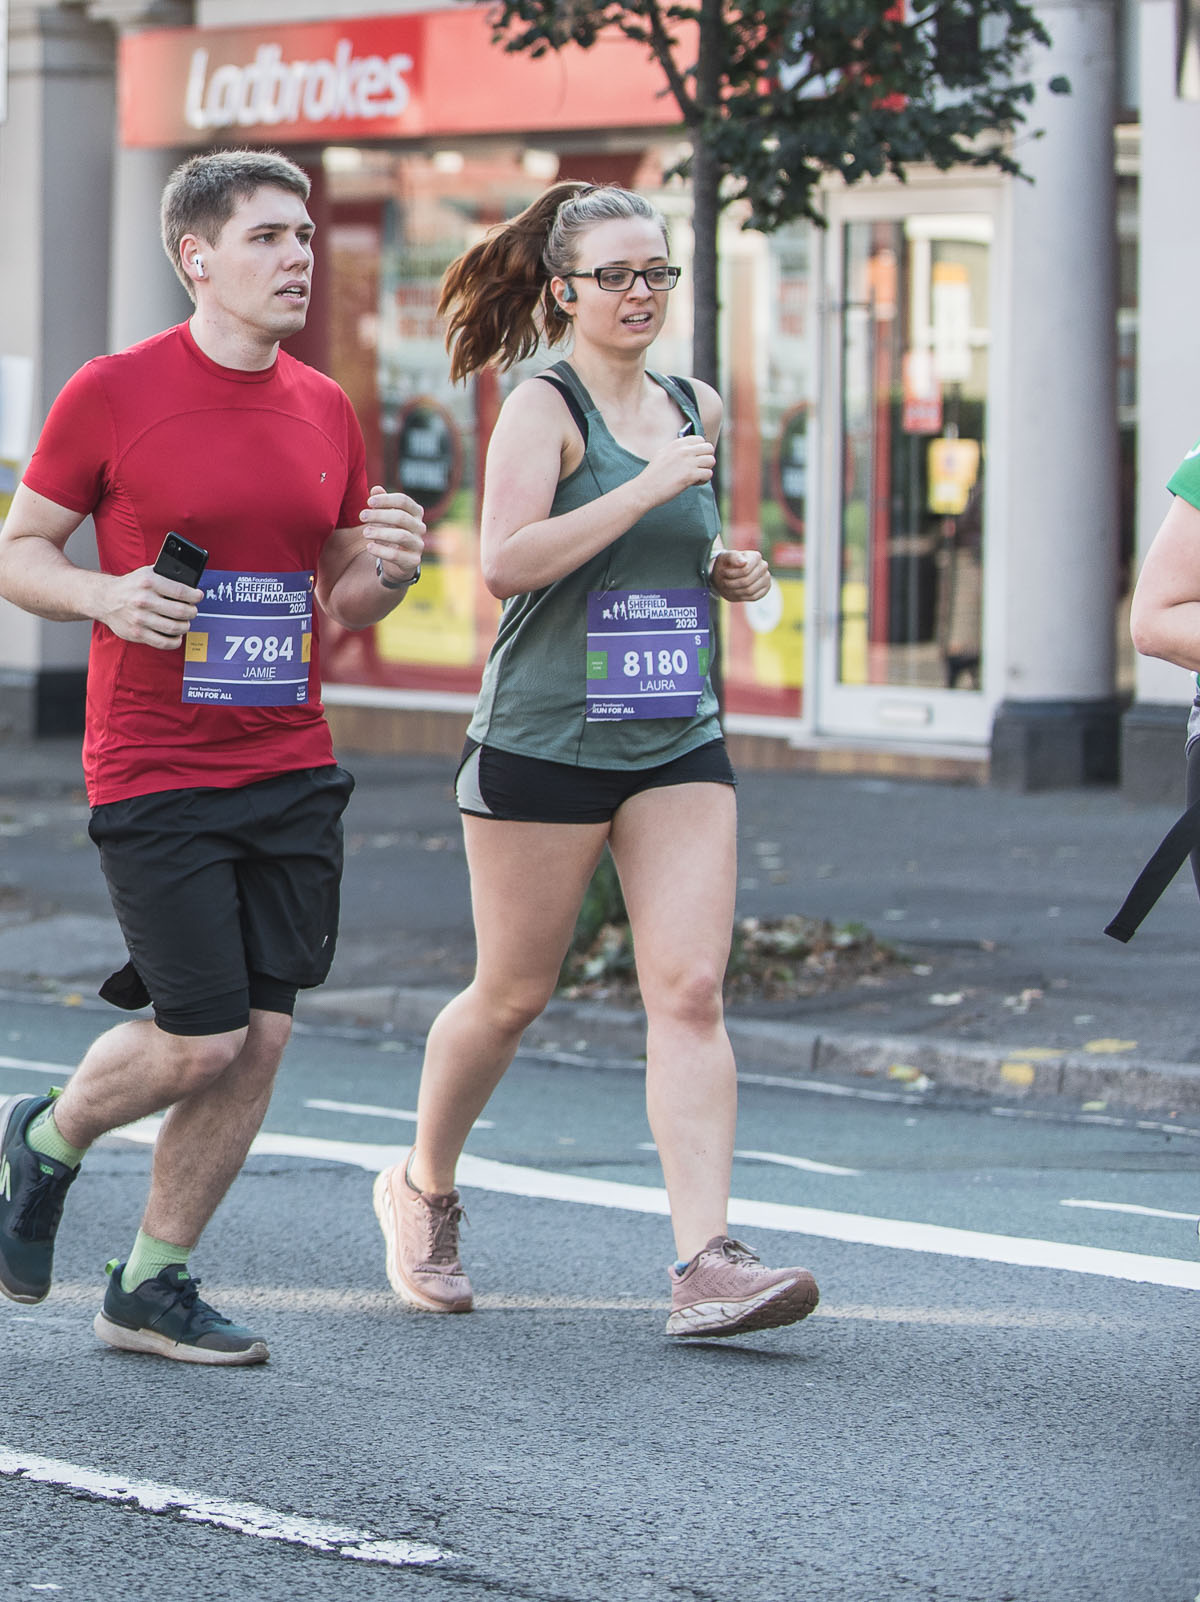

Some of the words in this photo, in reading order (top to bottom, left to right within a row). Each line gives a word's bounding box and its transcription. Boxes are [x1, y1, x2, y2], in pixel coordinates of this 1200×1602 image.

[185, 38, 414, 129] Ladbrokes
[237, 583, 283, 592] SHEFFIELD
[236, 593, 261, 603] HALF
[263, 591, 306, 603] MARATHON
[289, 603, 306, 613] 2020
[629, 600, 666, 609] SHEFFIELD
[629, 609, 650, 619] HALF
[651, 608, 696, 618] MARATHON
[675, 619, 698, 629] 2020
[223, 636, 294, 662] 7984
[623, 649, 688, 677] 8180
[243, 667, 277, 678] JAMIE
[640, 679, 676, 691] LAURA
